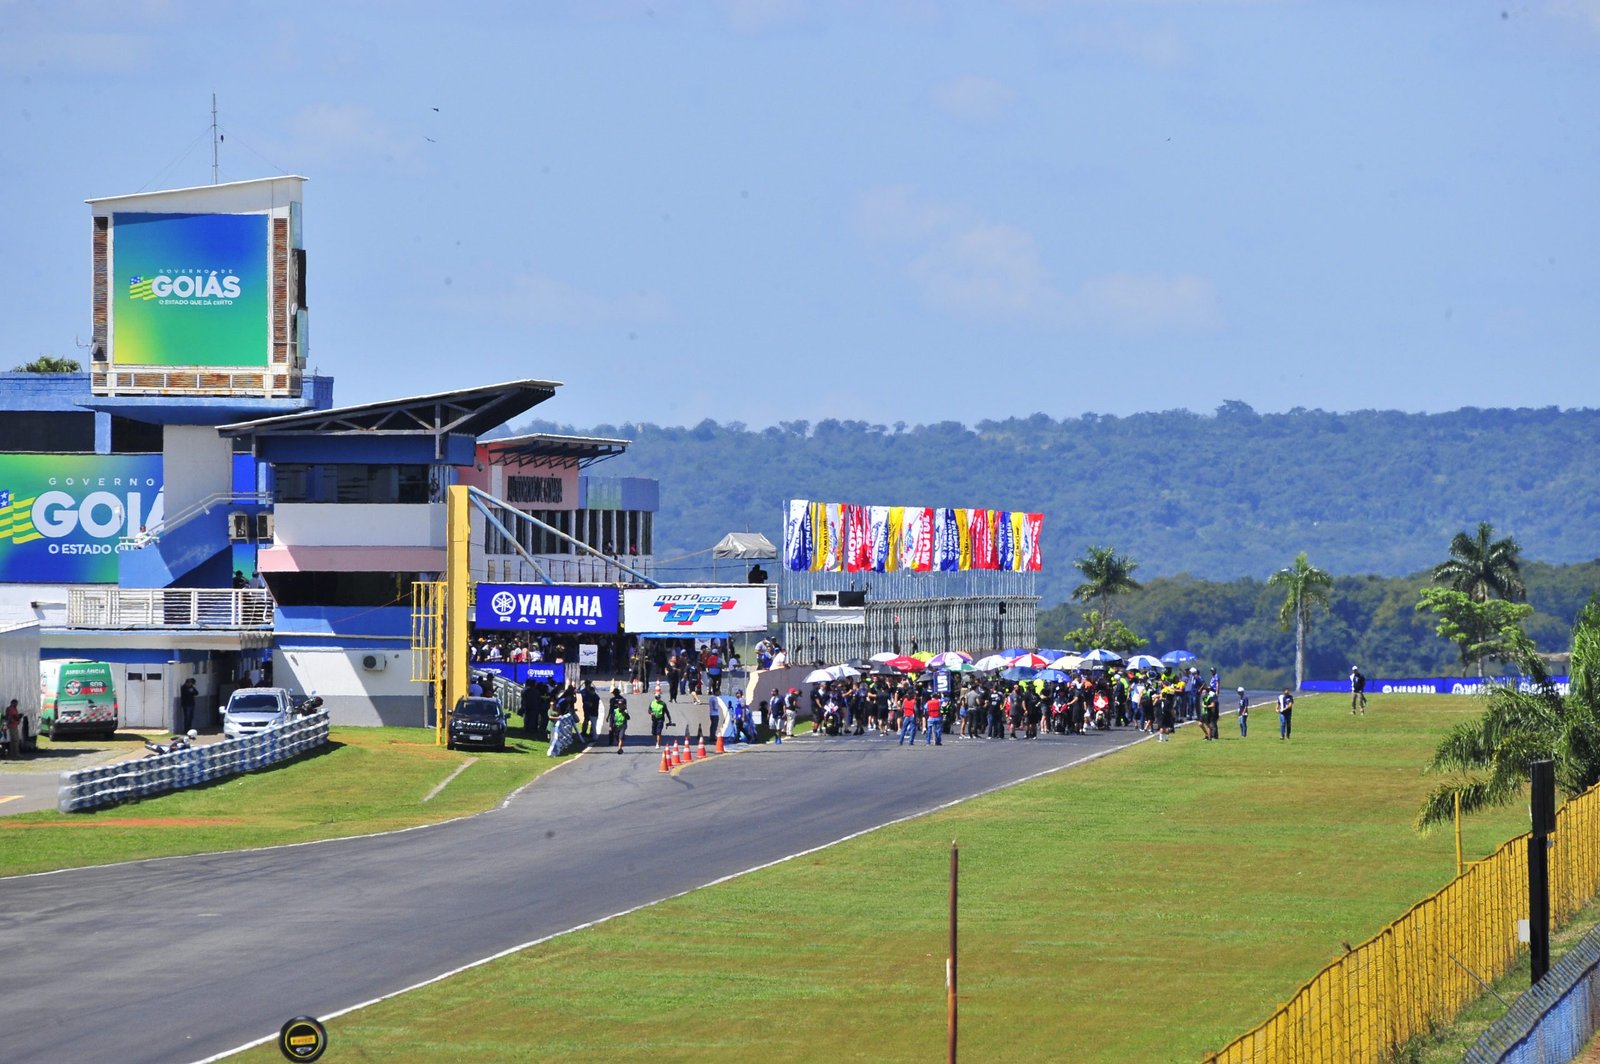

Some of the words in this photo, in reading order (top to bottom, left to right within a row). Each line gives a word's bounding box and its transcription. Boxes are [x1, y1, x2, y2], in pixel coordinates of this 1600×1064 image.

[151, 271, 241, 298] GOIÁS
[48, 477, 154, 486] GOVERNO
[48, 544, 59, 554] O
[62, 544, 112, 555] ESTADO
[517, 593, 603, 618] YAMAHA
[663, 604, 722, 622] GP
[499, 616, 597, 625] RACING
[936, 675, 948, 688] 5
